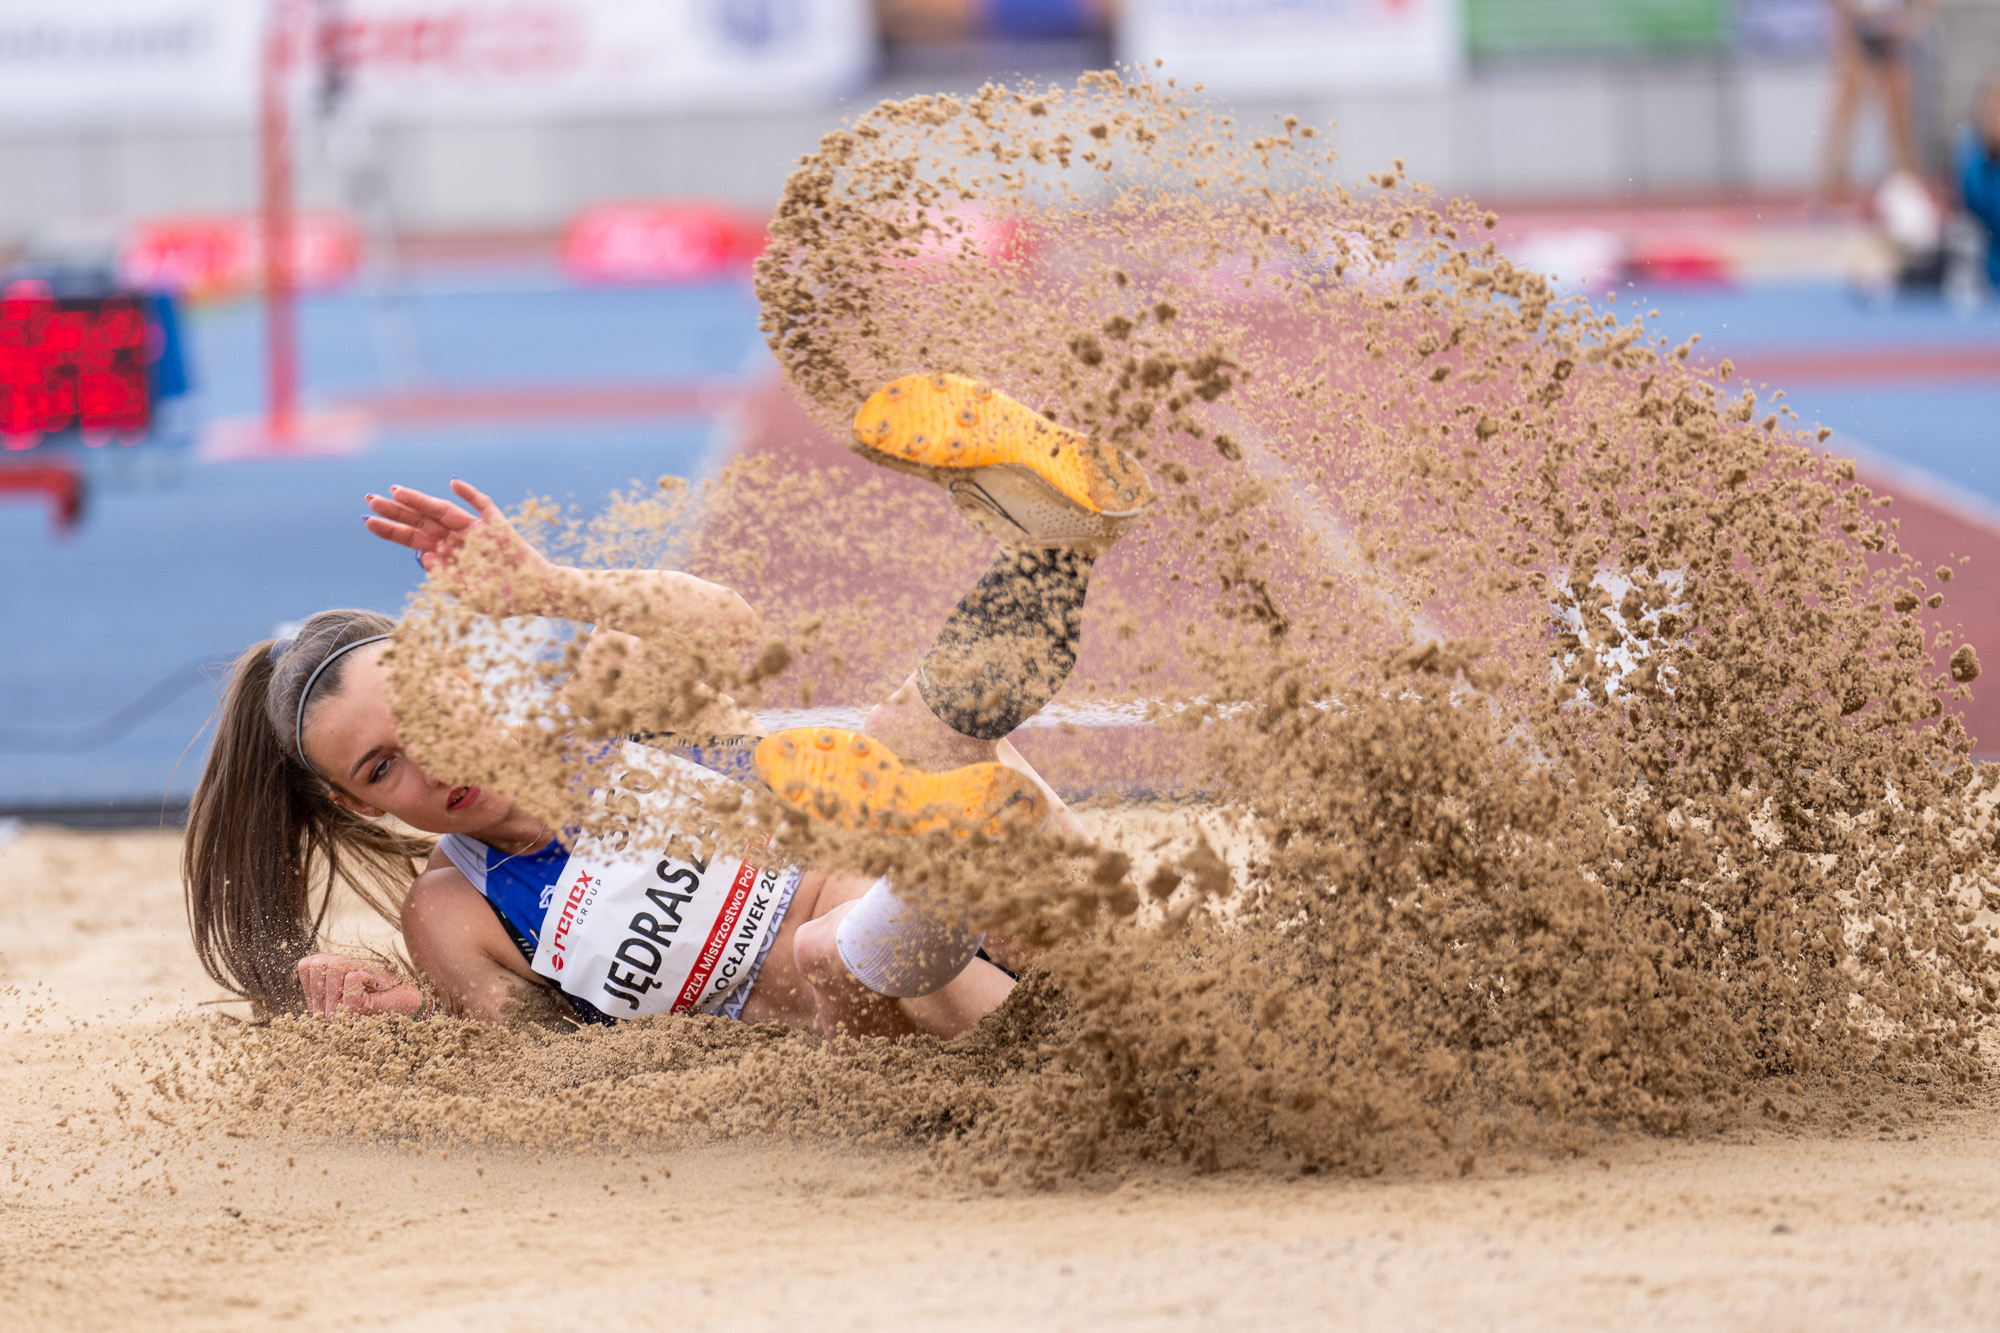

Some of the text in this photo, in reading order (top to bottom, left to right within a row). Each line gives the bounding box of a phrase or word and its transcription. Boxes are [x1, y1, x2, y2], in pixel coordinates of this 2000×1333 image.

[576, 878, 602, 926] GROUP
[683, 972, 707, 1002] PZLA
[699, 889, 746, 971] Mistrzostwa
[703, 893, 770, 1004] OCŁAWEK
